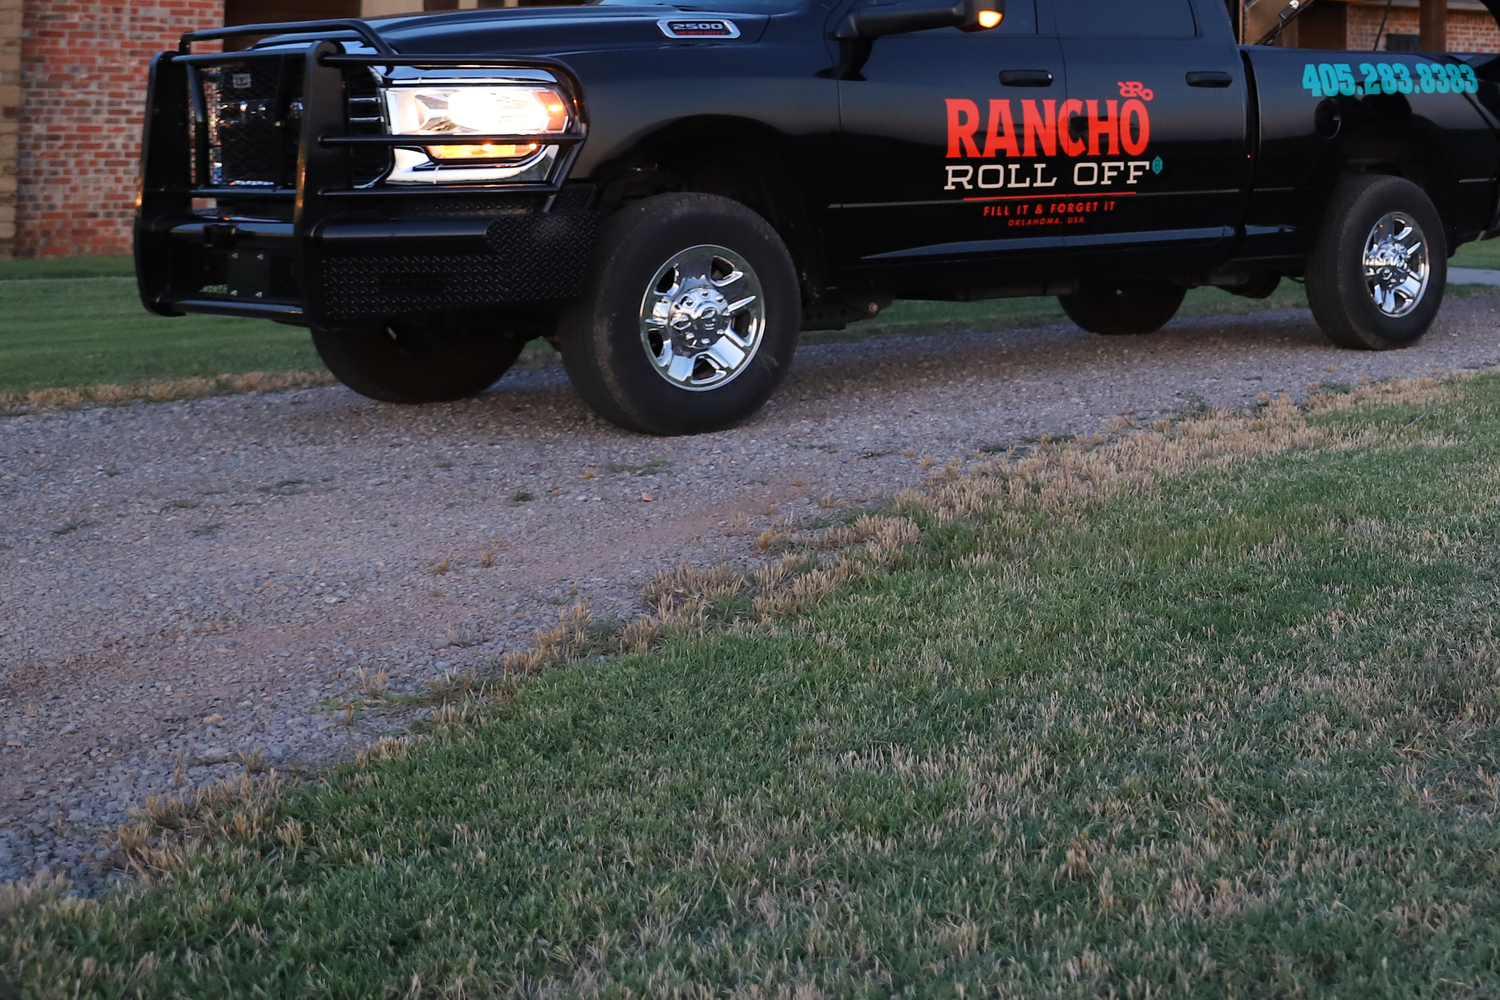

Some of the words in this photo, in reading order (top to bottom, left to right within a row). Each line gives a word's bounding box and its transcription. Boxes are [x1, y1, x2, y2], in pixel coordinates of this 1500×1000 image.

[1302, 63, 1478, 97] 405.283.8383
[944, 98, 1150, 158] RANCHO
[944, 163, 1057, 190] ROLL
[1073, 161, 1150, 186] OFF
[983, 205, 1010, 217] FILL
[1016, 204, 1029, 215] IT
[1034, 204, 1043, 215] &
[1050, 202, 1099, 213] FORGET
[1104, 201, 1116, 211] IT
[1007, 217, 1063, 227] OKLAHOMA,
[1067, 216, 1084, 224] USA
